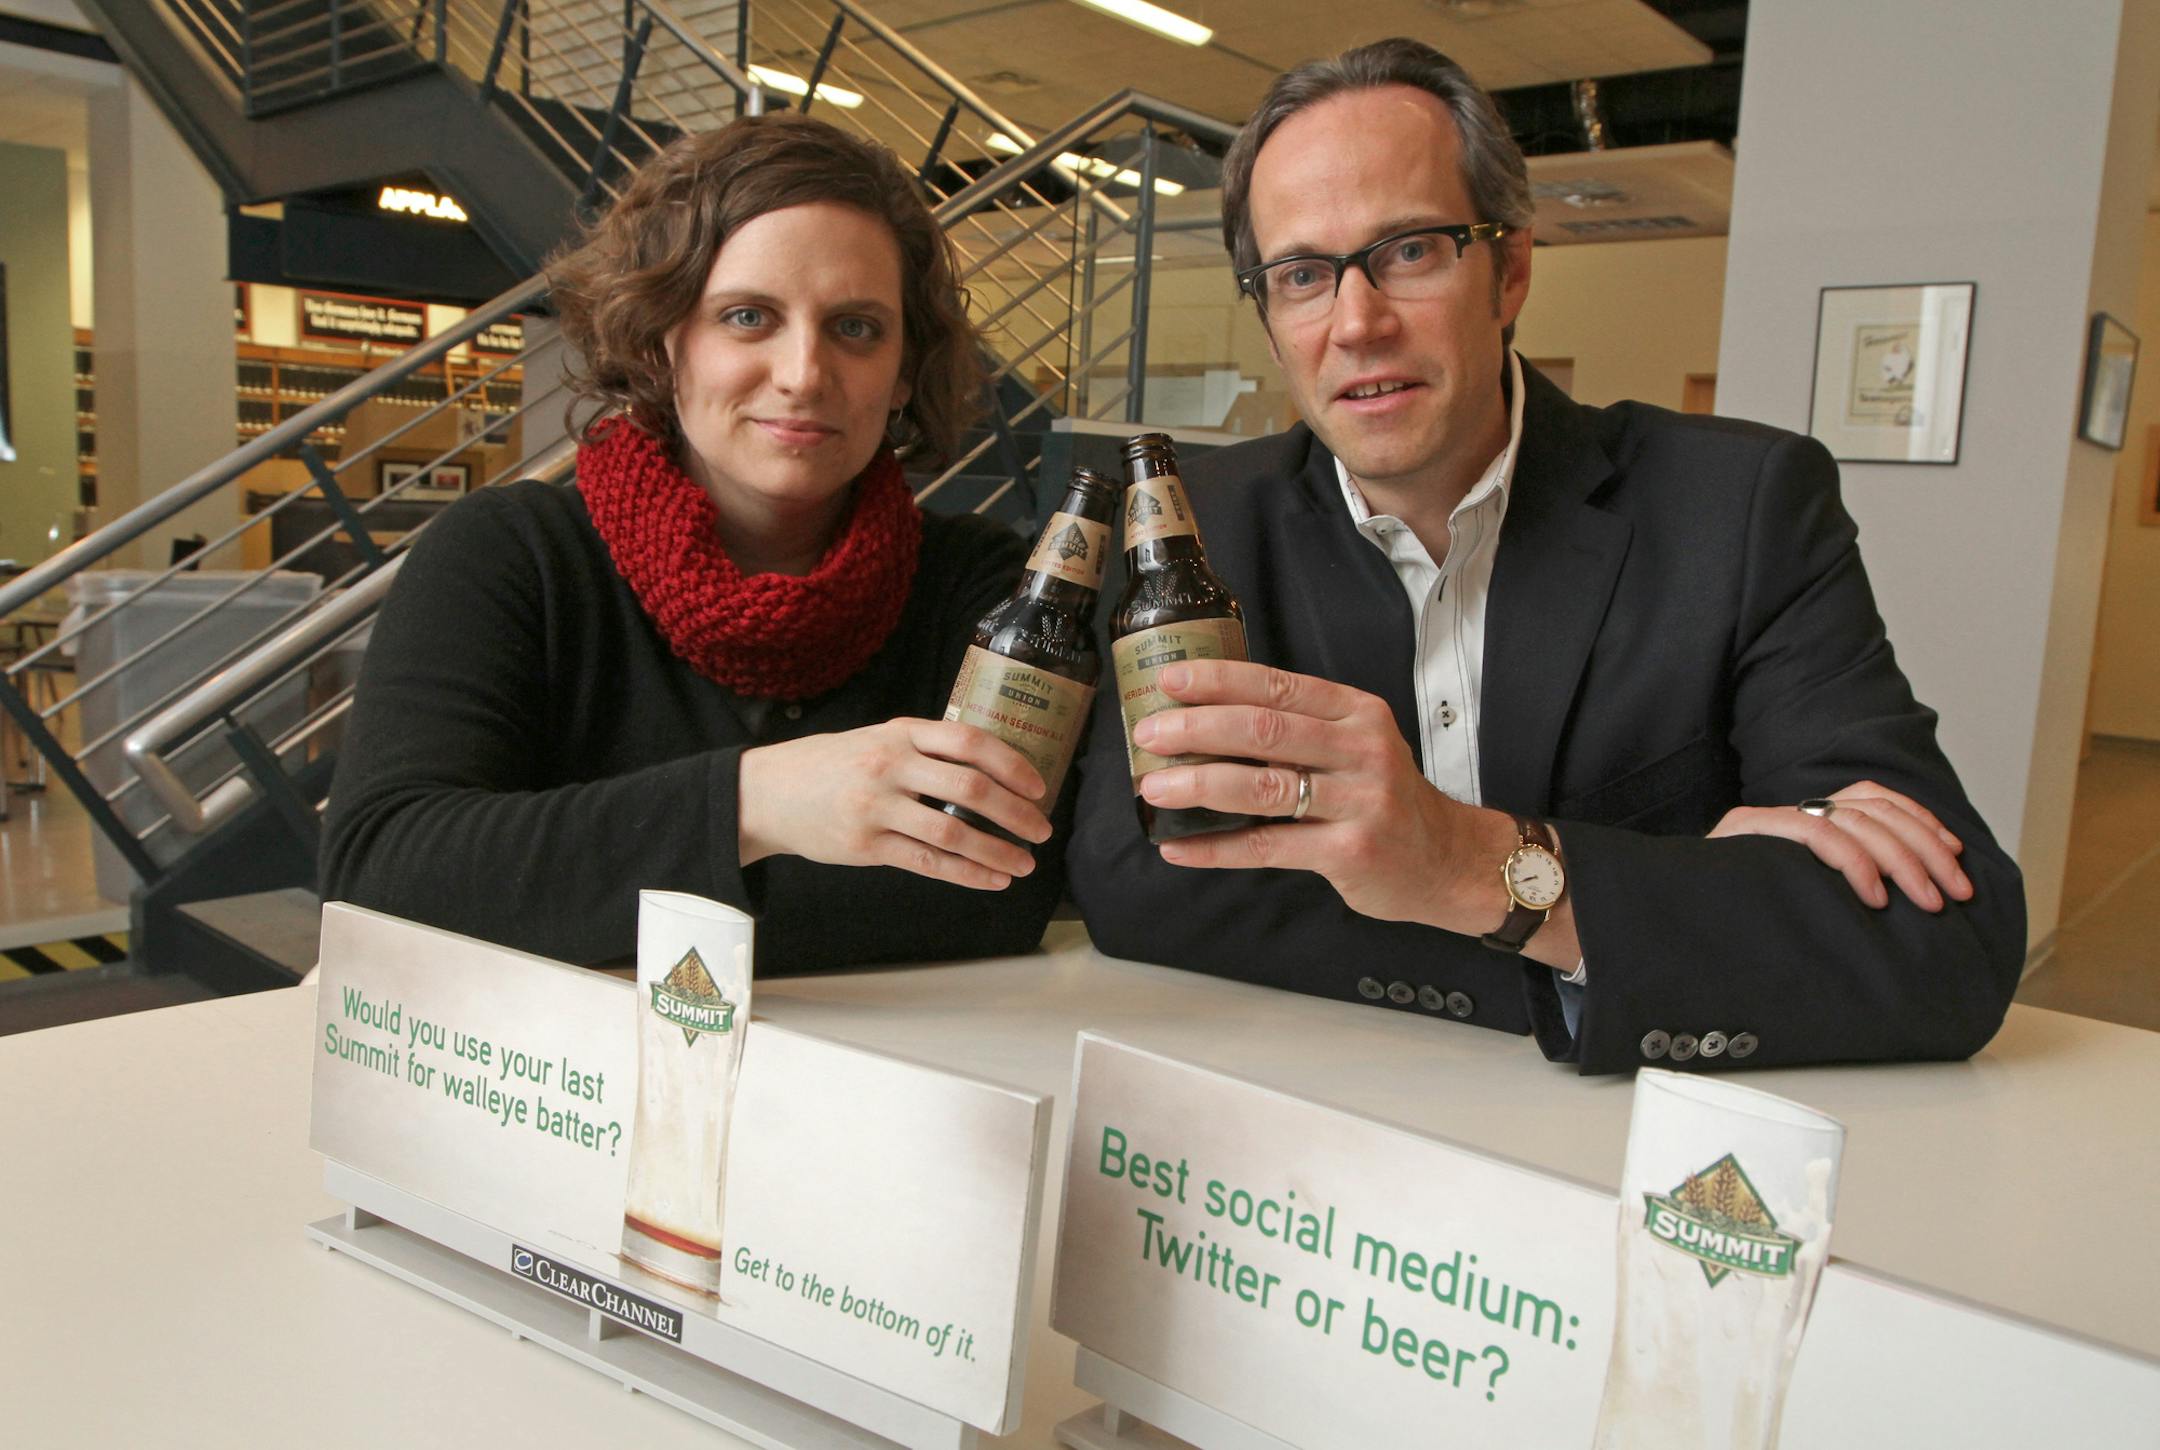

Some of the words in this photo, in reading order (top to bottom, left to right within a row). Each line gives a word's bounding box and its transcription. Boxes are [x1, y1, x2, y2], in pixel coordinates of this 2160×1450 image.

[1135, 634, 1182, 655] SUMMIT
[1145, 652, 1177, 666] UNION
[1003, 671, 1053, 694] SUMMIT
[1008, 688, 1041, 706] UNION
[1009, 717, 1048, 738] SESSION
[656, 993, 728, 1026] SUMMIT
[342, 985, 402, 1036] Would
[408, 1014, 446, 1051] you
[453, 1031, 492, 1066] use
[501, 1047, 553, 1086] your
[561, 1057, 605, 1105] last
[324, 1023, 401, 1078] Summit
[407, 1053, 436, 1089] for
[444, 1071, 528, 1127] walleye
[536, 1097, 622, 1157] batter?
[1100, 1126, 1189, 1203] Best
[1204, 1179, 1337, 1260] social
[1353, 1231, 1580, 1351] medium:
[1652, 1210, 1786, 1267] SUMMIT
[734, 1247, 770, 1282] Get
[776, 1263, 796, 1292] to
[801, 1273, 835, 1306] the
[840, 1285, 921, 1341] bottom
[926, 1323, 953, 1357] of
[956, 1328, 976, 1362] it.
[1137, 1208, 1281, 1309] Twitter
[1295, 1289, 1345, 1334] or
[1361, 1296, 1510, 1402] beer?
